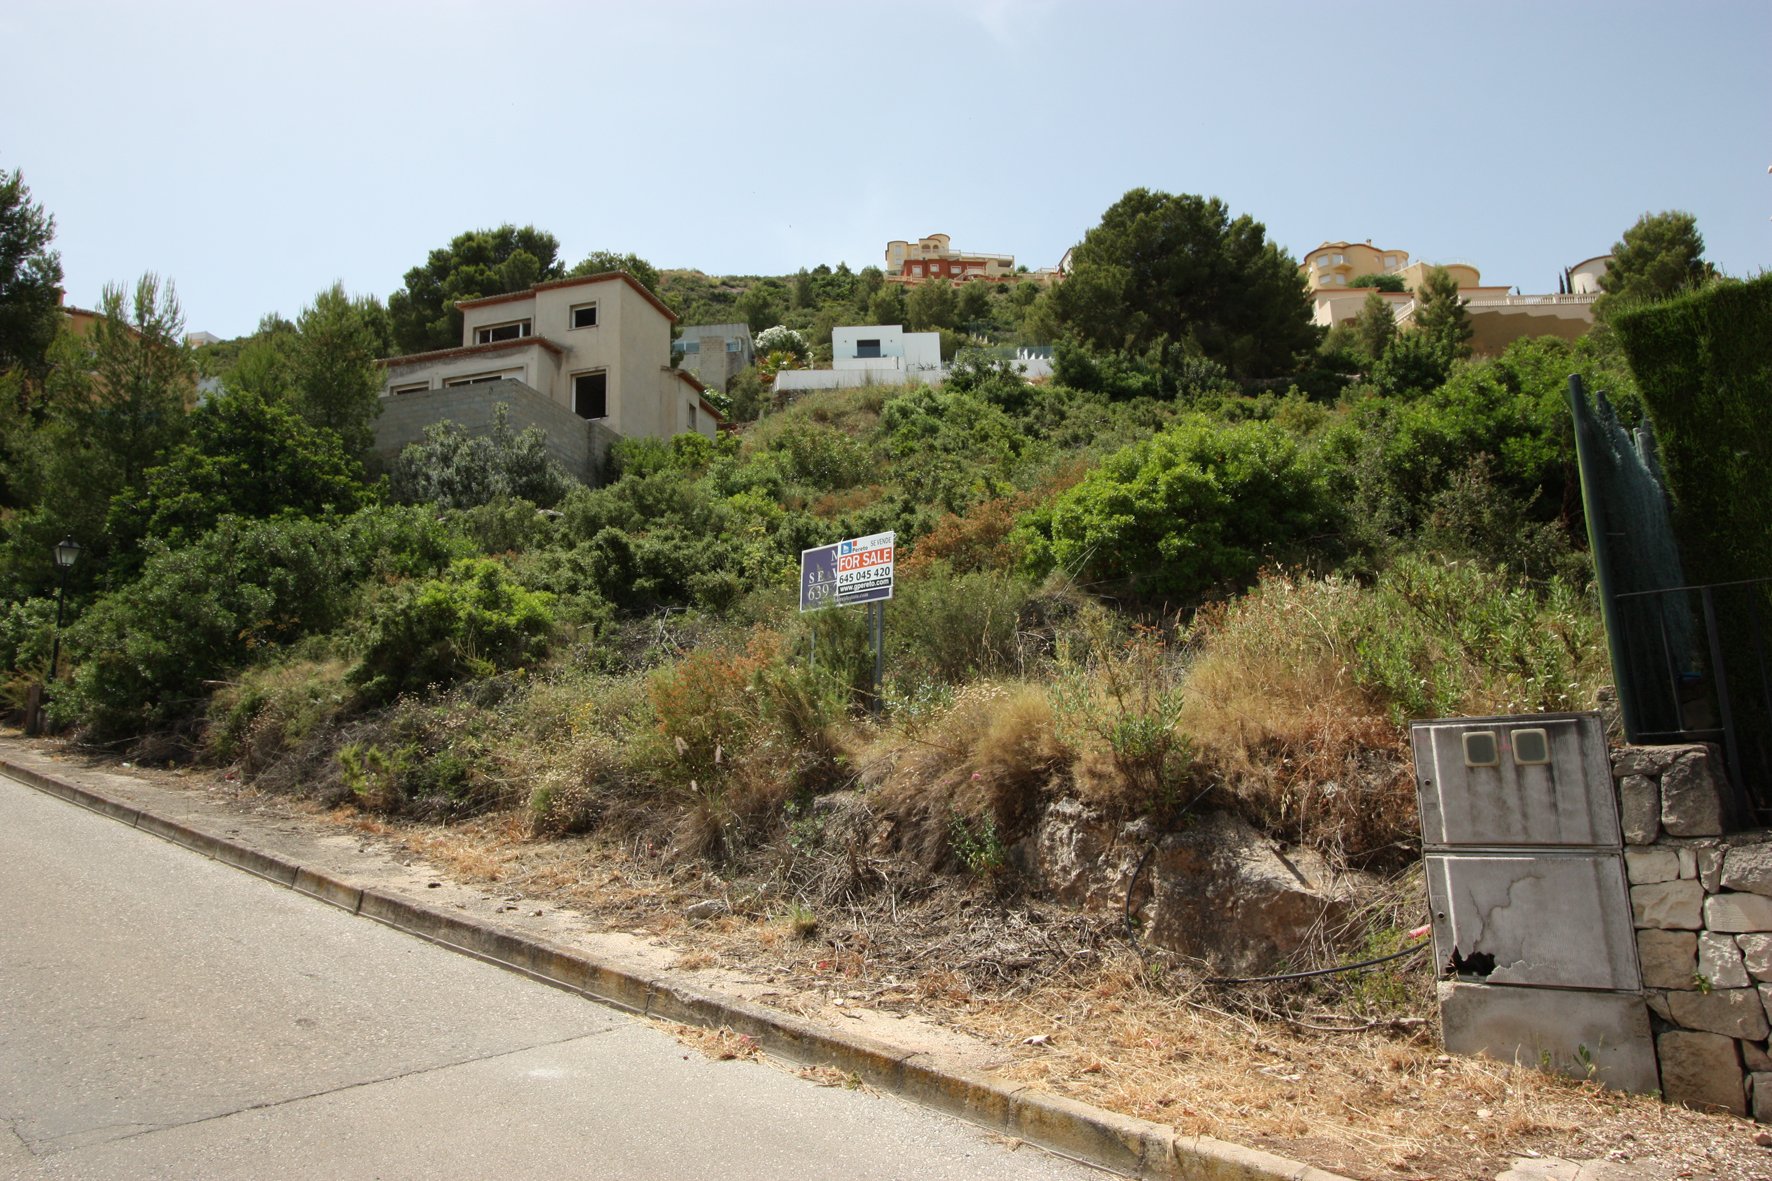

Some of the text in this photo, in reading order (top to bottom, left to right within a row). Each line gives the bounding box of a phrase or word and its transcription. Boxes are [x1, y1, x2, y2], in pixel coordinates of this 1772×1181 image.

[877, 537, 891, 545] VENDE
[840, 549, 890, 570] FOR SALE
[839, 573, 853, 584] 645
[856, 570, 871, 581] 045
[874, 567, 890, 578] 420
[840, 579, 889, 592] www.gpereto.com
